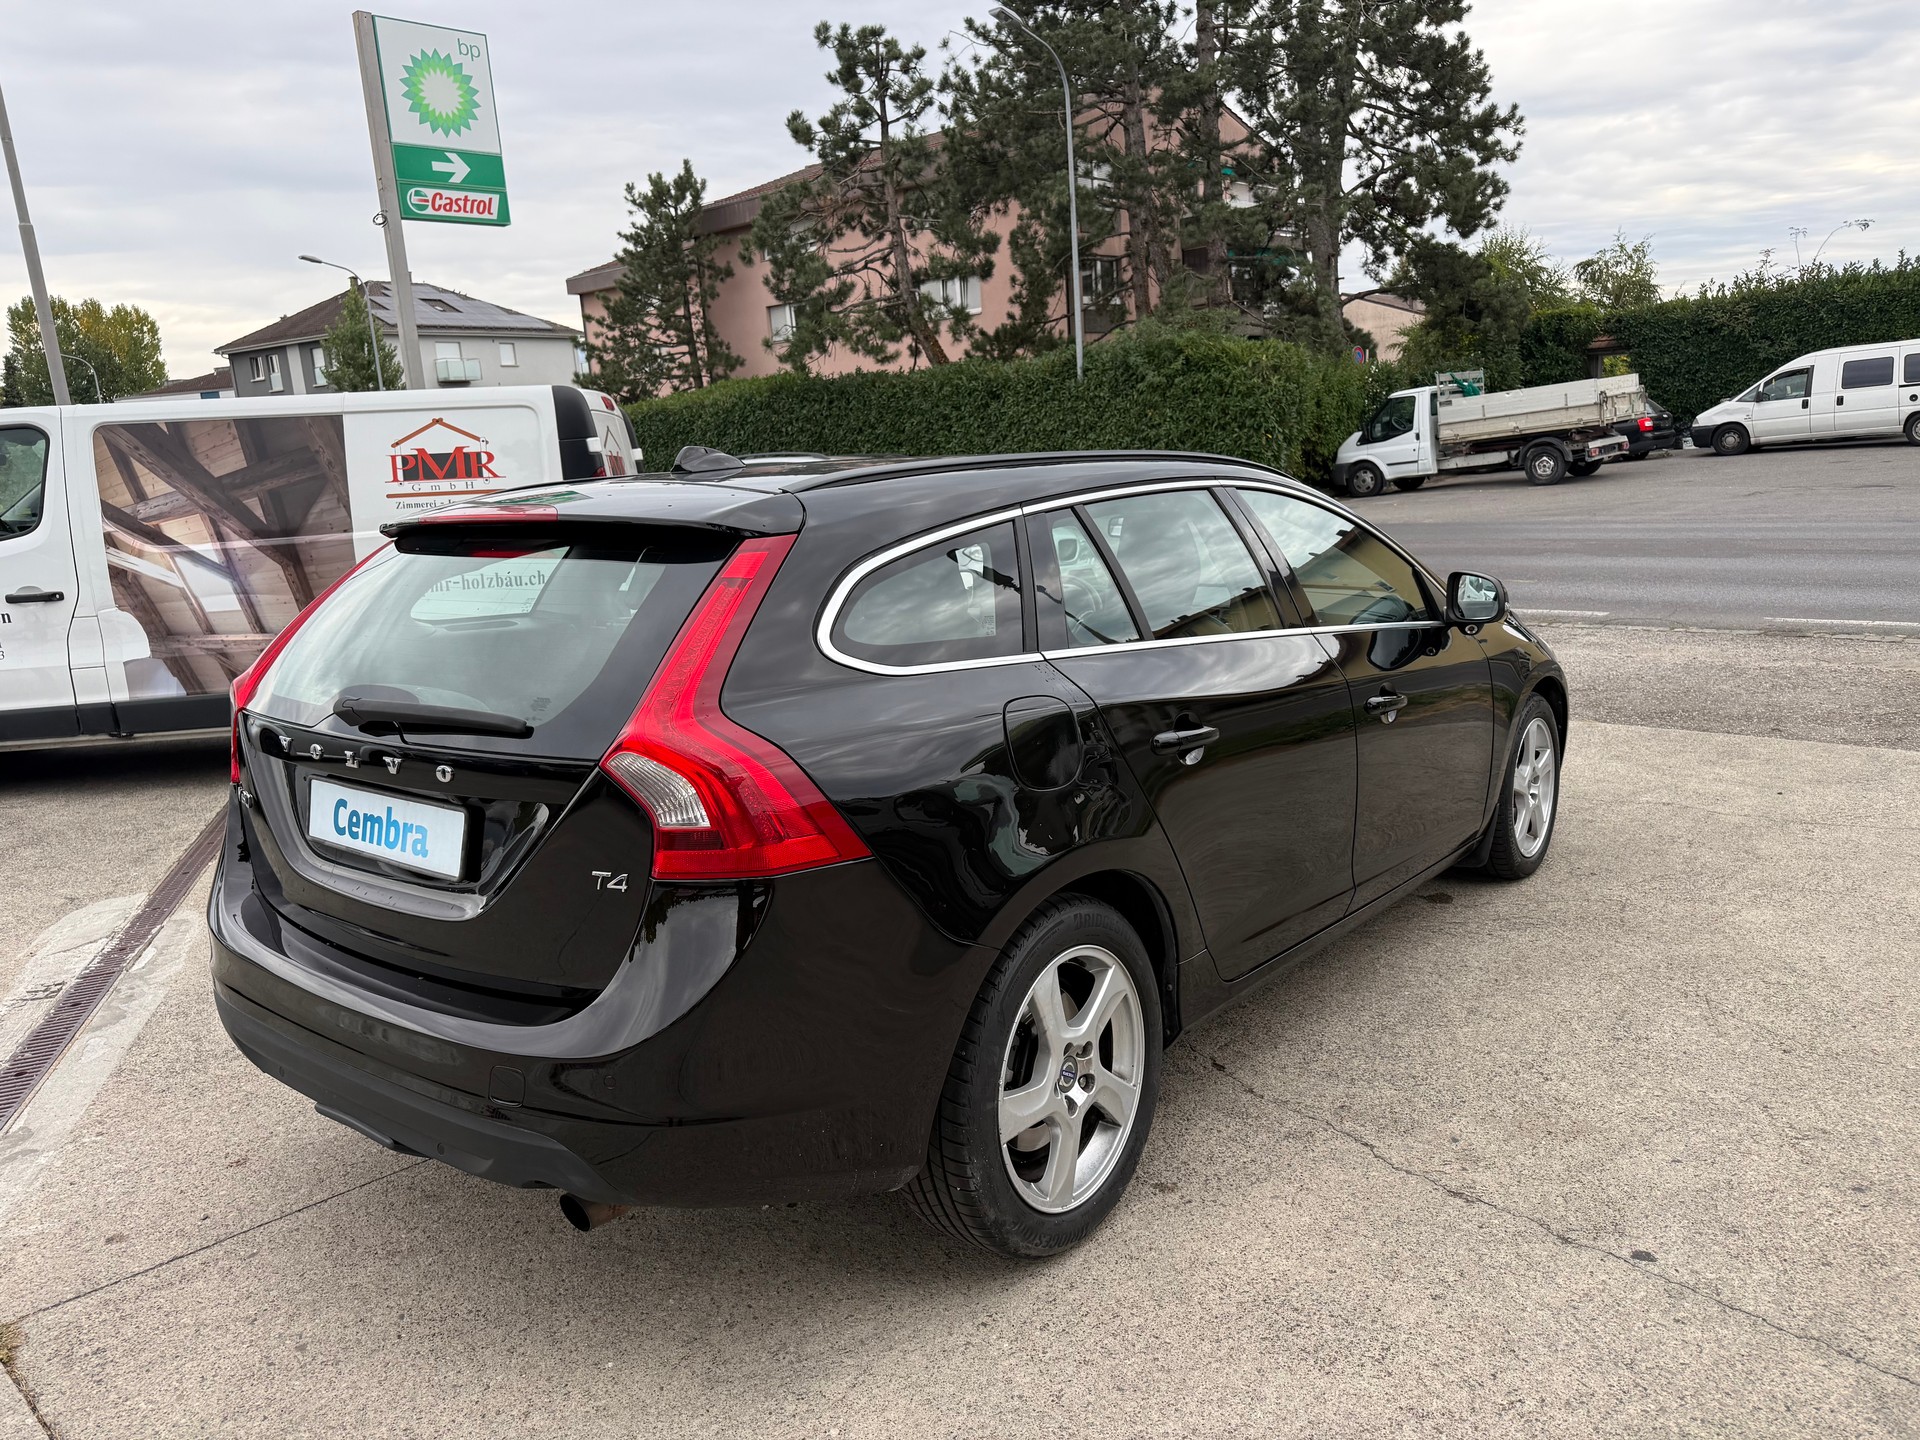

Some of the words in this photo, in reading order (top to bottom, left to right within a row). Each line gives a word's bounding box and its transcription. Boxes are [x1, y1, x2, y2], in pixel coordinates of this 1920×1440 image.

[457, 38, 481, 61] bp
[431, 192, 494, 215] Castrol
[385, 446, 507, 483] PMR
[395, 499, 438, 510] Zimmerei
[278, 735, 455, 783] VOLVO
[333, 798, 429, 859] Cembra
[591, 870, 629, 892] T4
